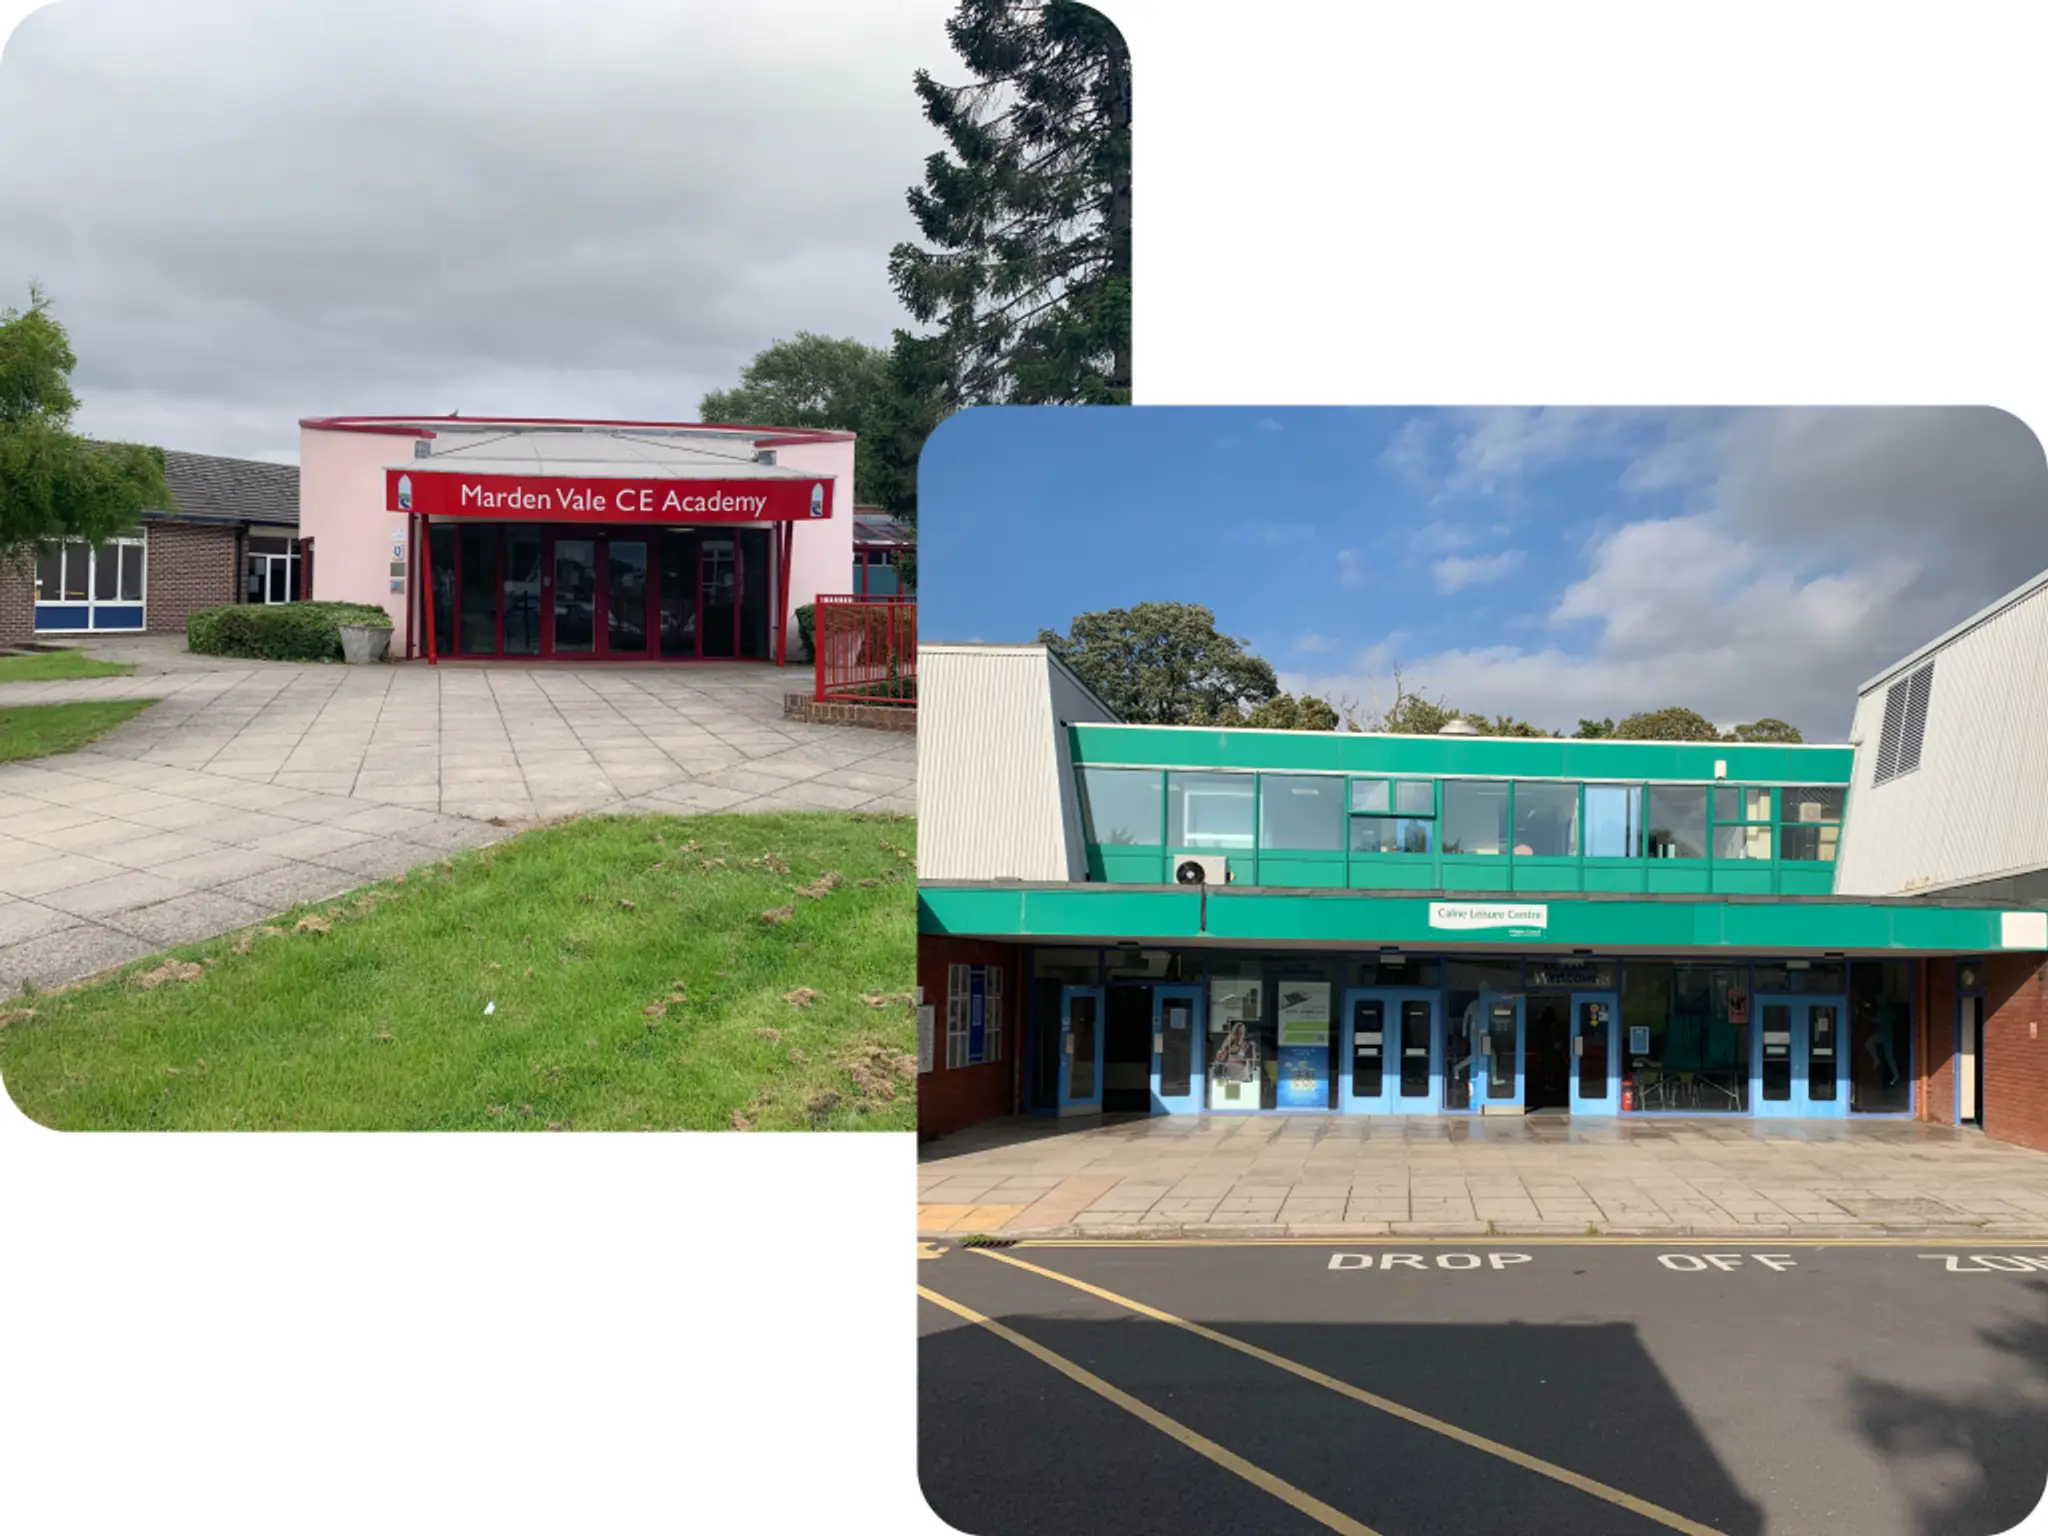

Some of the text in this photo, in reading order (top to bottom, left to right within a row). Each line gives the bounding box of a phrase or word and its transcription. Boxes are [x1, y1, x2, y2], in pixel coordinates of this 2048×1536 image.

[461, 484, 767, 518] Marden Vale CE Academy
[1469, 908, 1505, 920] Leisure
[1507, 910, 1543, 920] Centre
[1328, 1253, 1533, 1270] DROP
[1656, 1254, 1798, 1271] OFF
